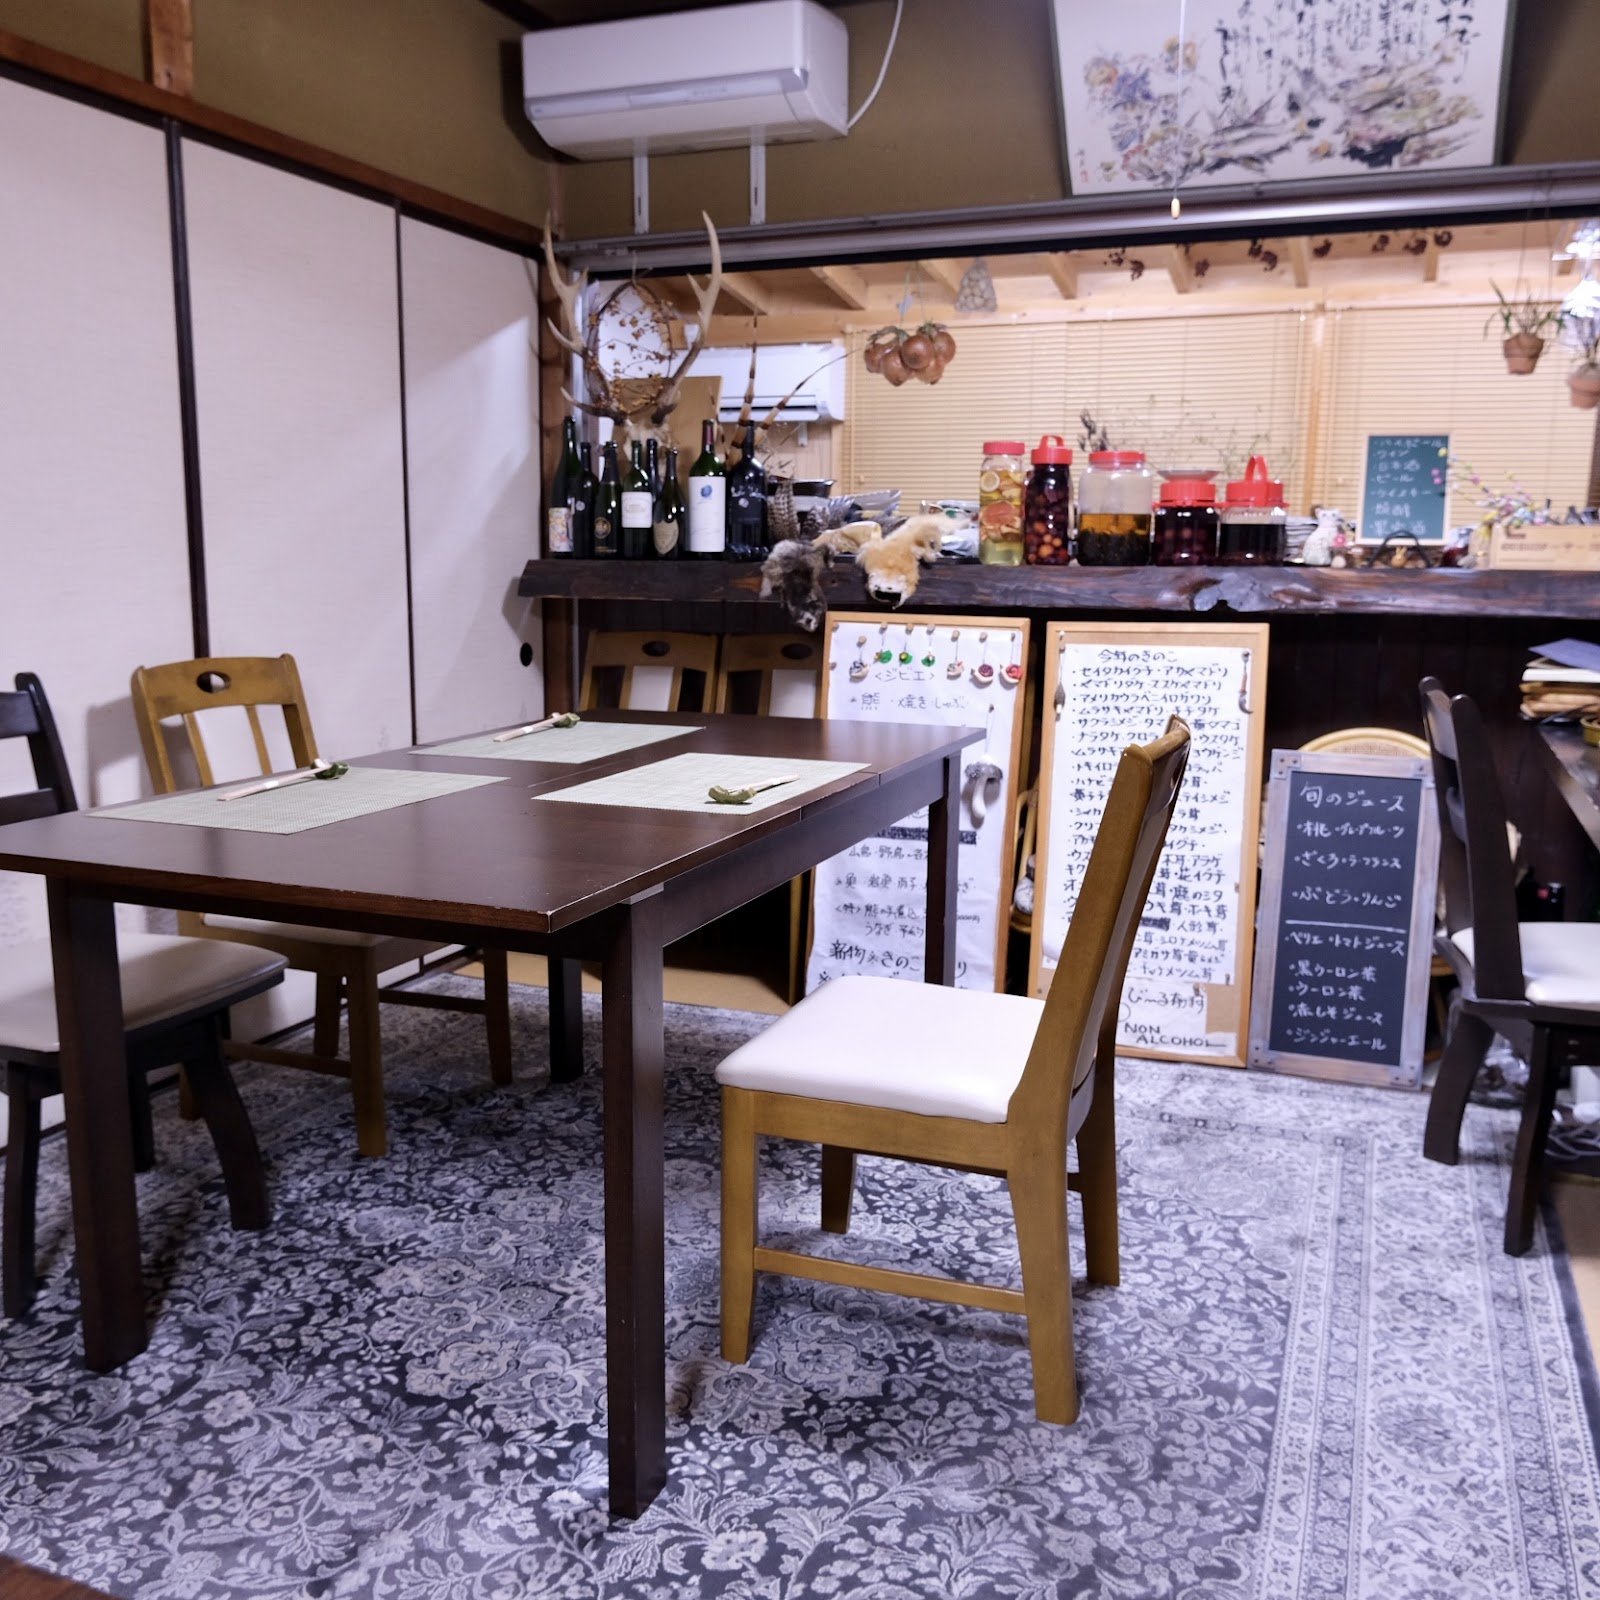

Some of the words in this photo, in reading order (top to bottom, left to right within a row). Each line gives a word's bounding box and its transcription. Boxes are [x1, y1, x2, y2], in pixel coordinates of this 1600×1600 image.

[1300, 781, 1405, 813] 旬のジュース
[1302, 820, 1331, 838] 桃
[1298, 885, 1352, 905] ぶどう
[1361, 891, 1402, 909] りんご
[1295, 981, 1366, 1001] ウーロン茶
[1124, 1022, 1160, 1034] NON
[1136, 1034, 1227, 1048] ALCOHOL
